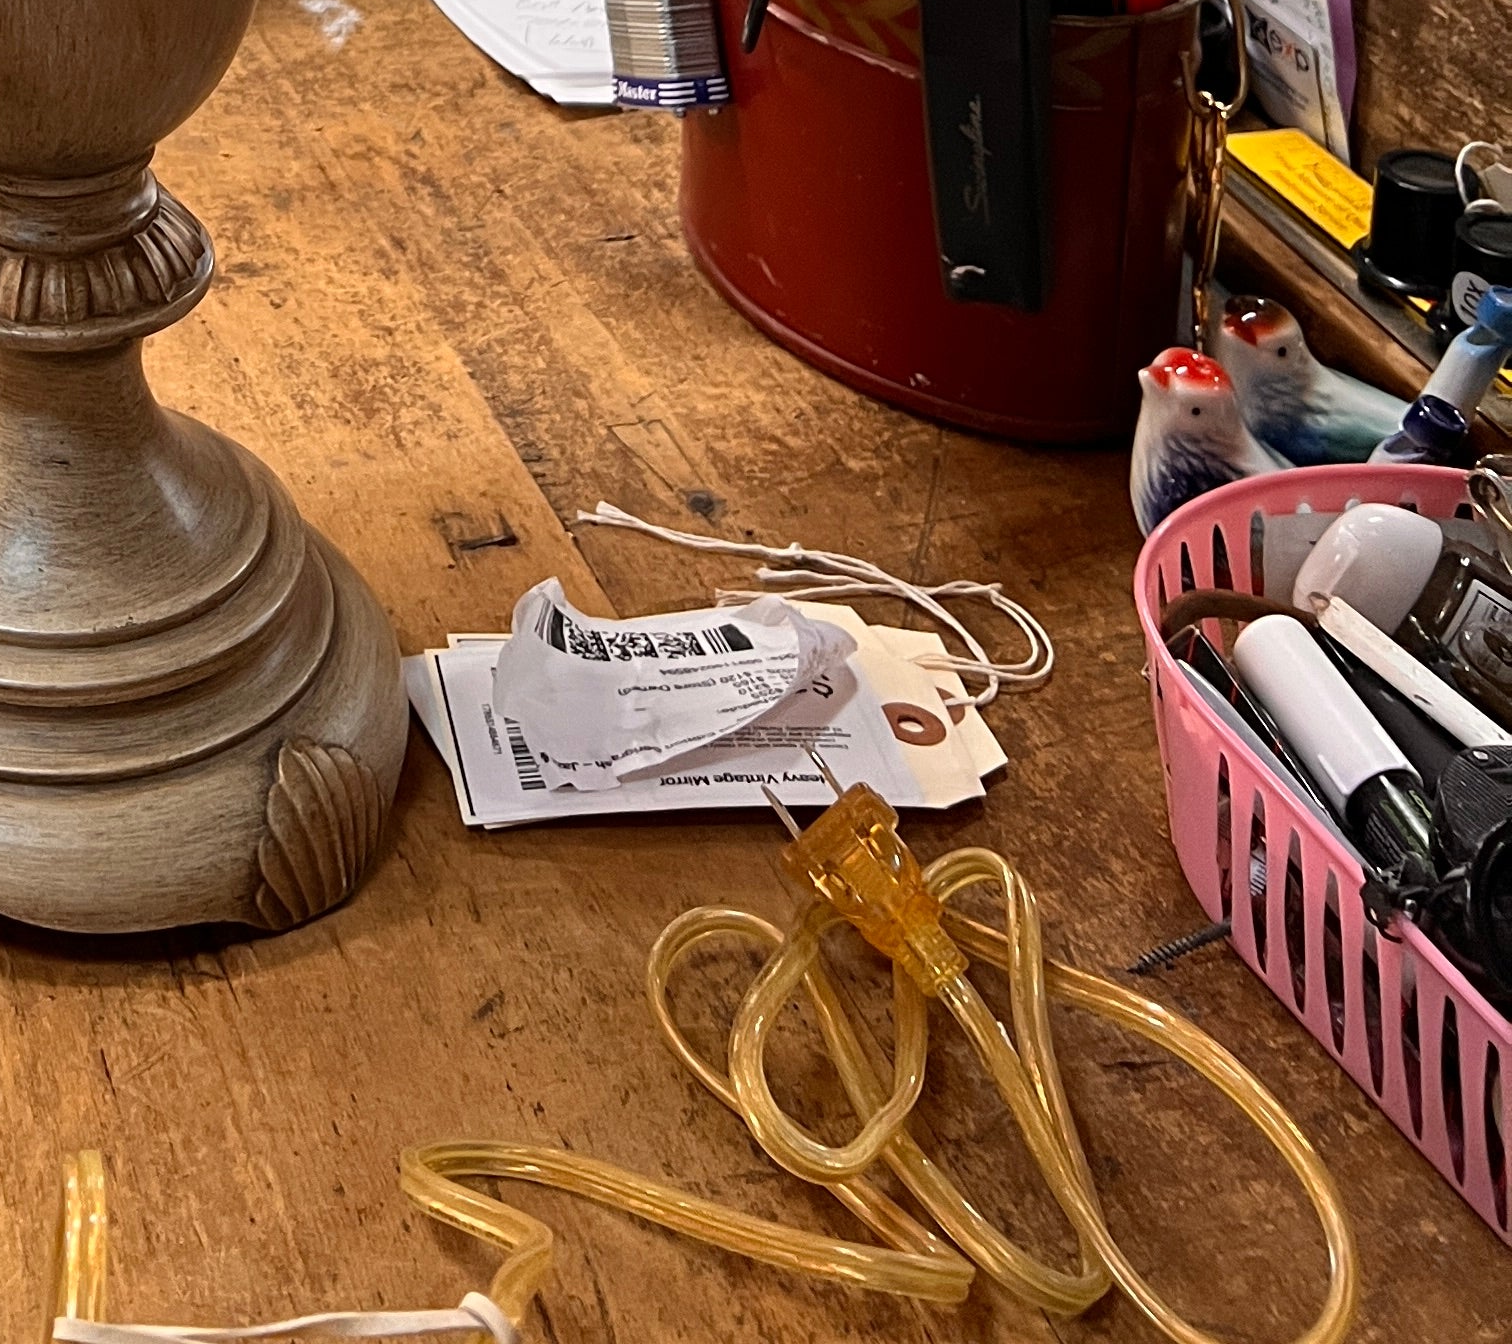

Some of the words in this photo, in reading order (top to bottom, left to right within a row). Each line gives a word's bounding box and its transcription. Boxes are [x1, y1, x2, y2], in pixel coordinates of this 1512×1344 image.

[618, 80, 657, 101] Master
[659, 774, 710, 787] Mirror
[714, 771, 778, 785] Vintage
